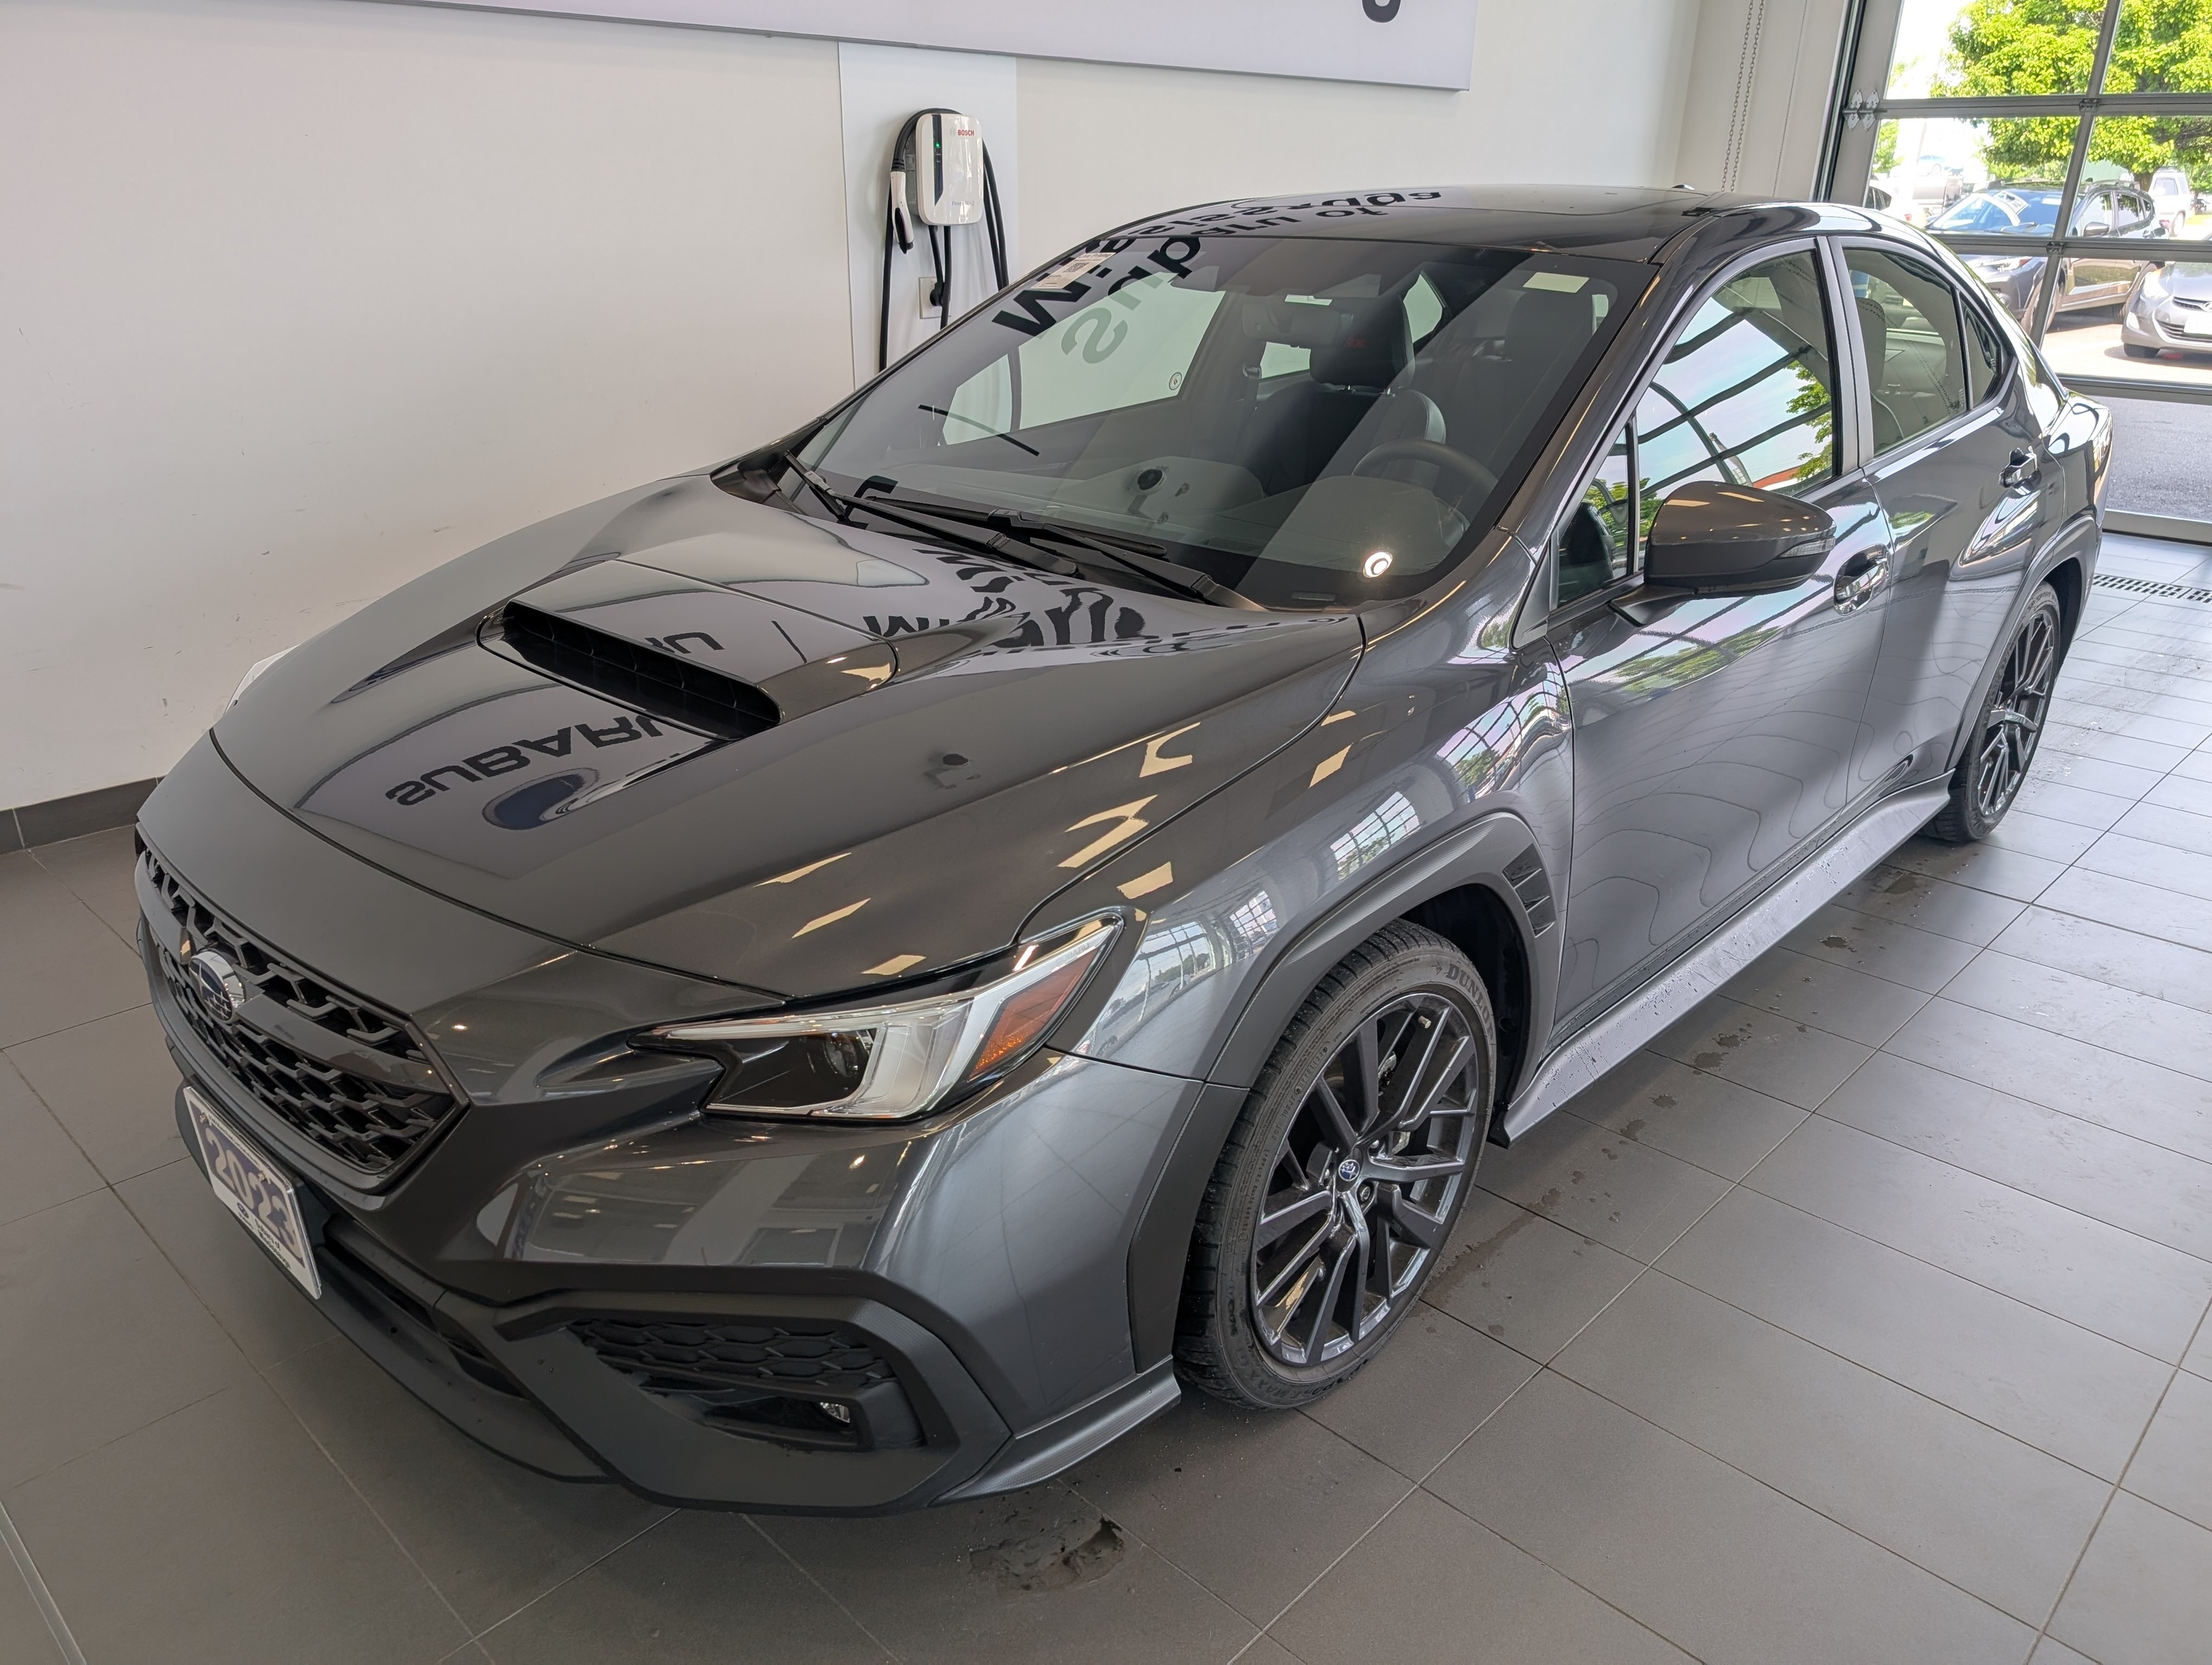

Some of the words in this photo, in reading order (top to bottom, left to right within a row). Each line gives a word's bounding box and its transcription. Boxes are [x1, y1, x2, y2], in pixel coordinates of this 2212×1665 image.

[1055, 943, 1090, 965] SUBARU
[1446, 963, 1494, 1041] DUNLOP
[204, 1128, 303, 1259] 2023
